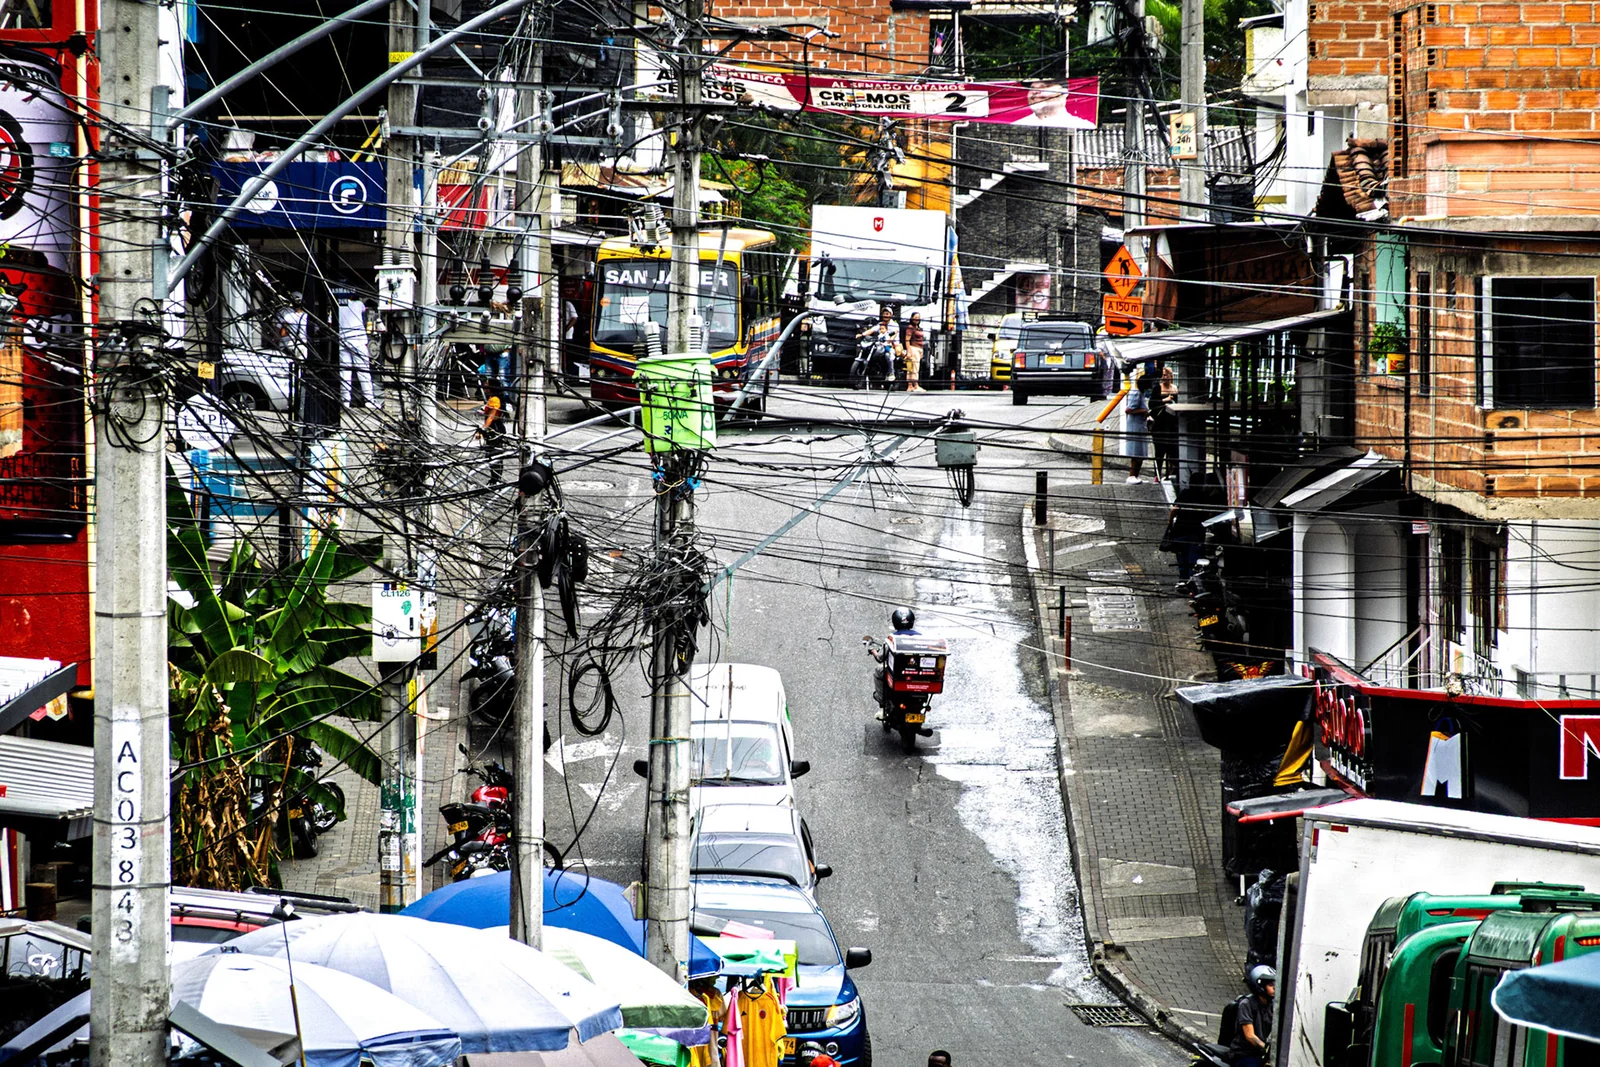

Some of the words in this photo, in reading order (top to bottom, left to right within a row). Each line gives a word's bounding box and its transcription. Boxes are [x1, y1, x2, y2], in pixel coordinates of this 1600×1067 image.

[831, 81, 848, 89] AL
[852, 82, 902, 91] SENADO
[906, 84, 966, 92] VOTAMOS
[831, 101, 861, 109] EQUIPO
[943, 92, 968, 113] 2
[605, 269, 648, 285] SAN
[652, 270, 729, 287] JAER
[1107, 301, 1114, 310] A
[1115, 301, 1130, 312] 150
[1131, 303, 1139, 313] m
[381, 590, 411, 598] CL1126
